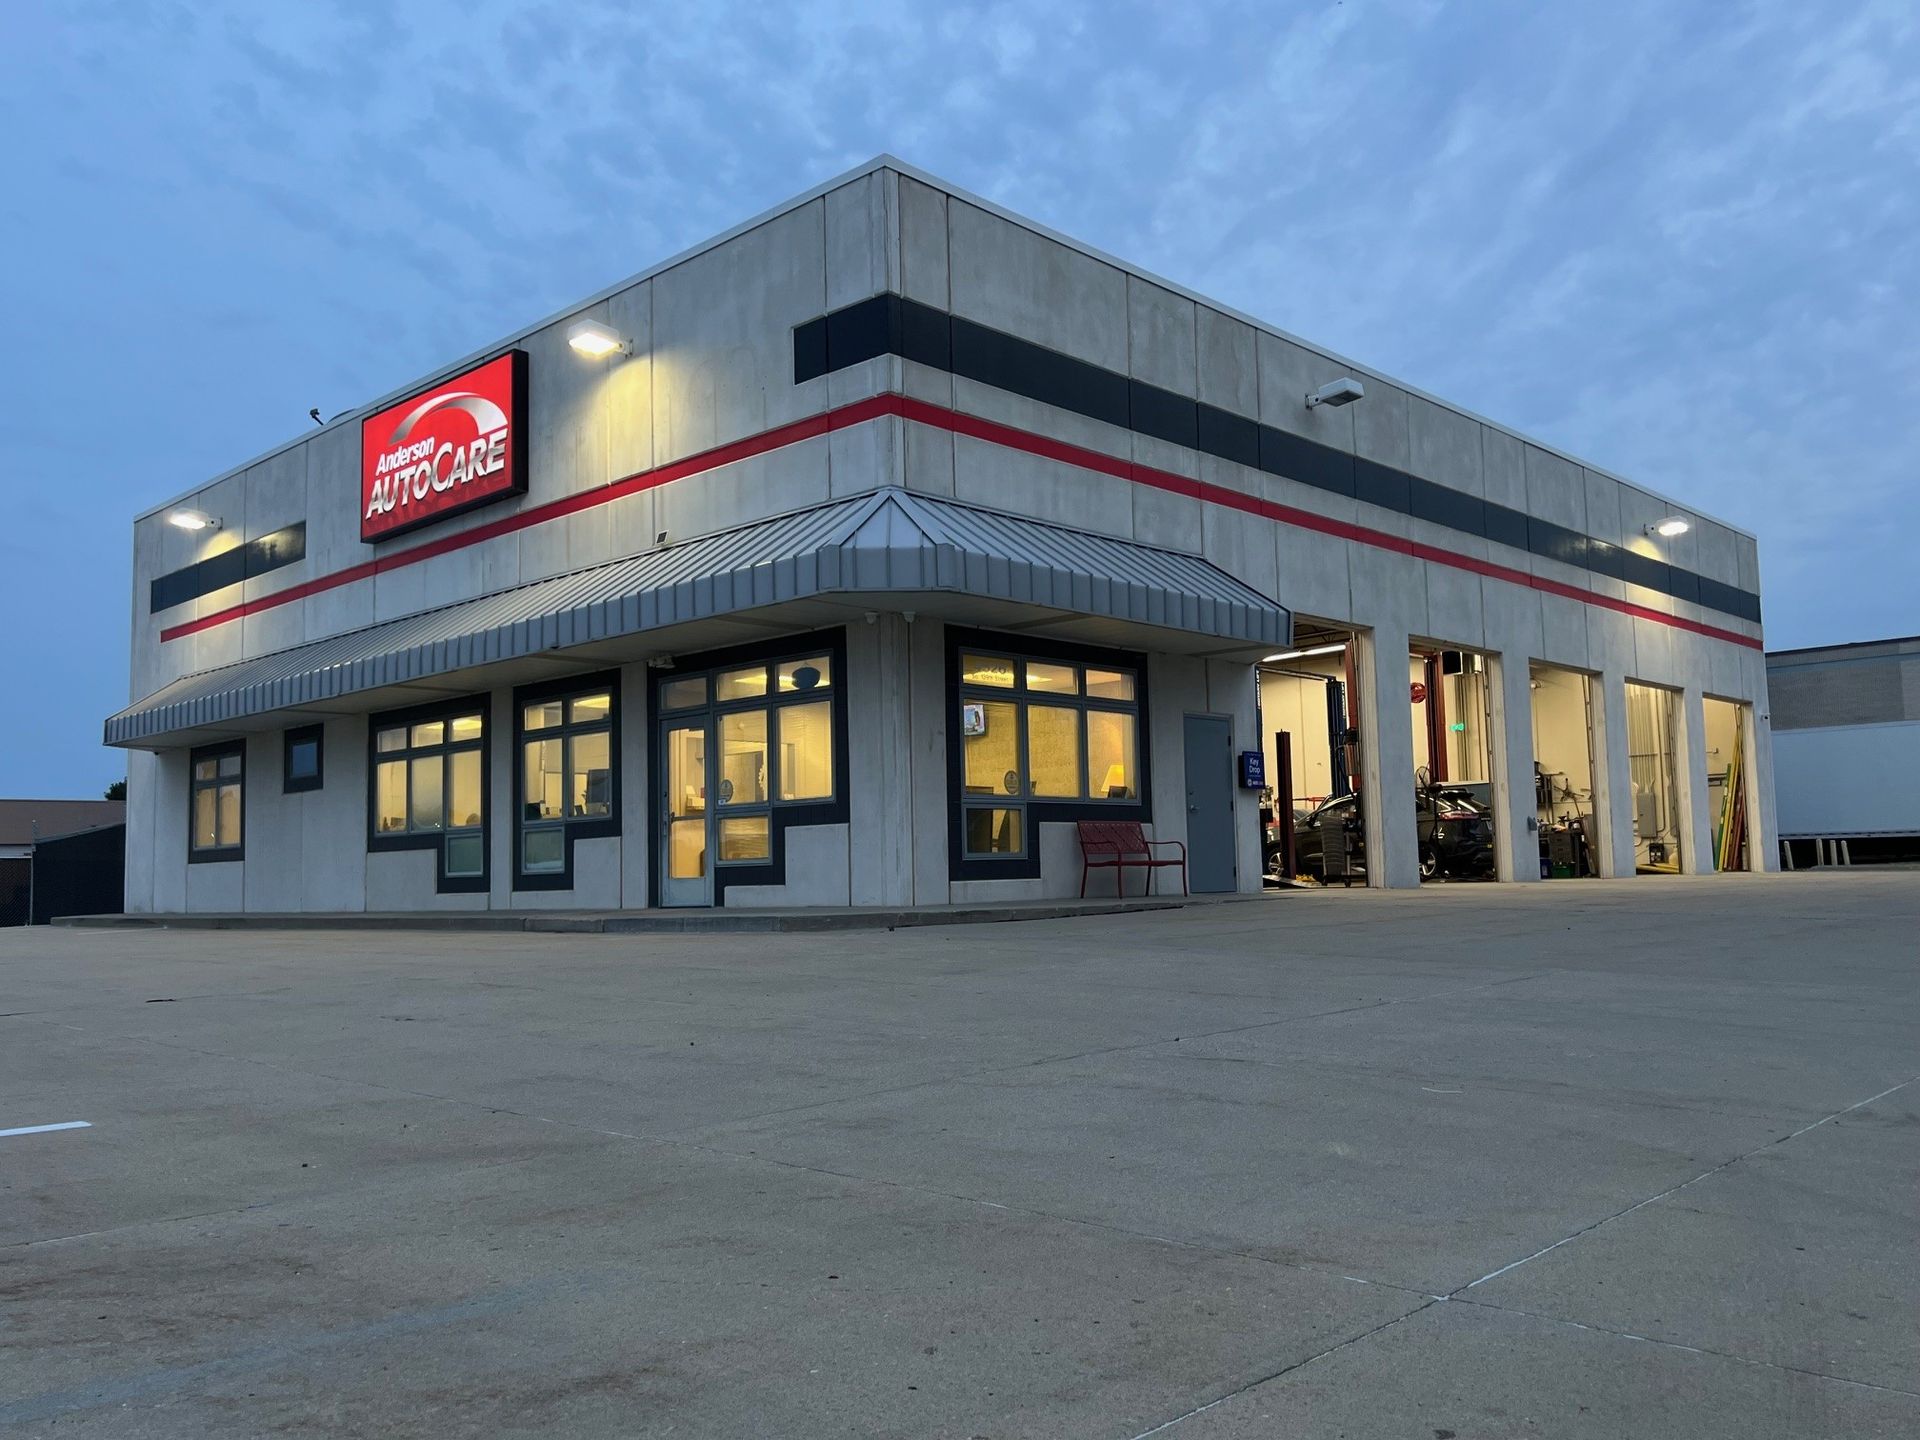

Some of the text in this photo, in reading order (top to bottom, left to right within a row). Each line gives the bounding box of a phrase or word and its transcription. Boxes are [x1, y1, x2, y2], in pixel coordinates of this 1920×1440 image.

[376, 436, 435, 476] Anderson
[365, 428, 508, 520] AUTOCARE
[1249, 766, 1260, 774] Drop
[1250, 758, 1259, 766] Key
